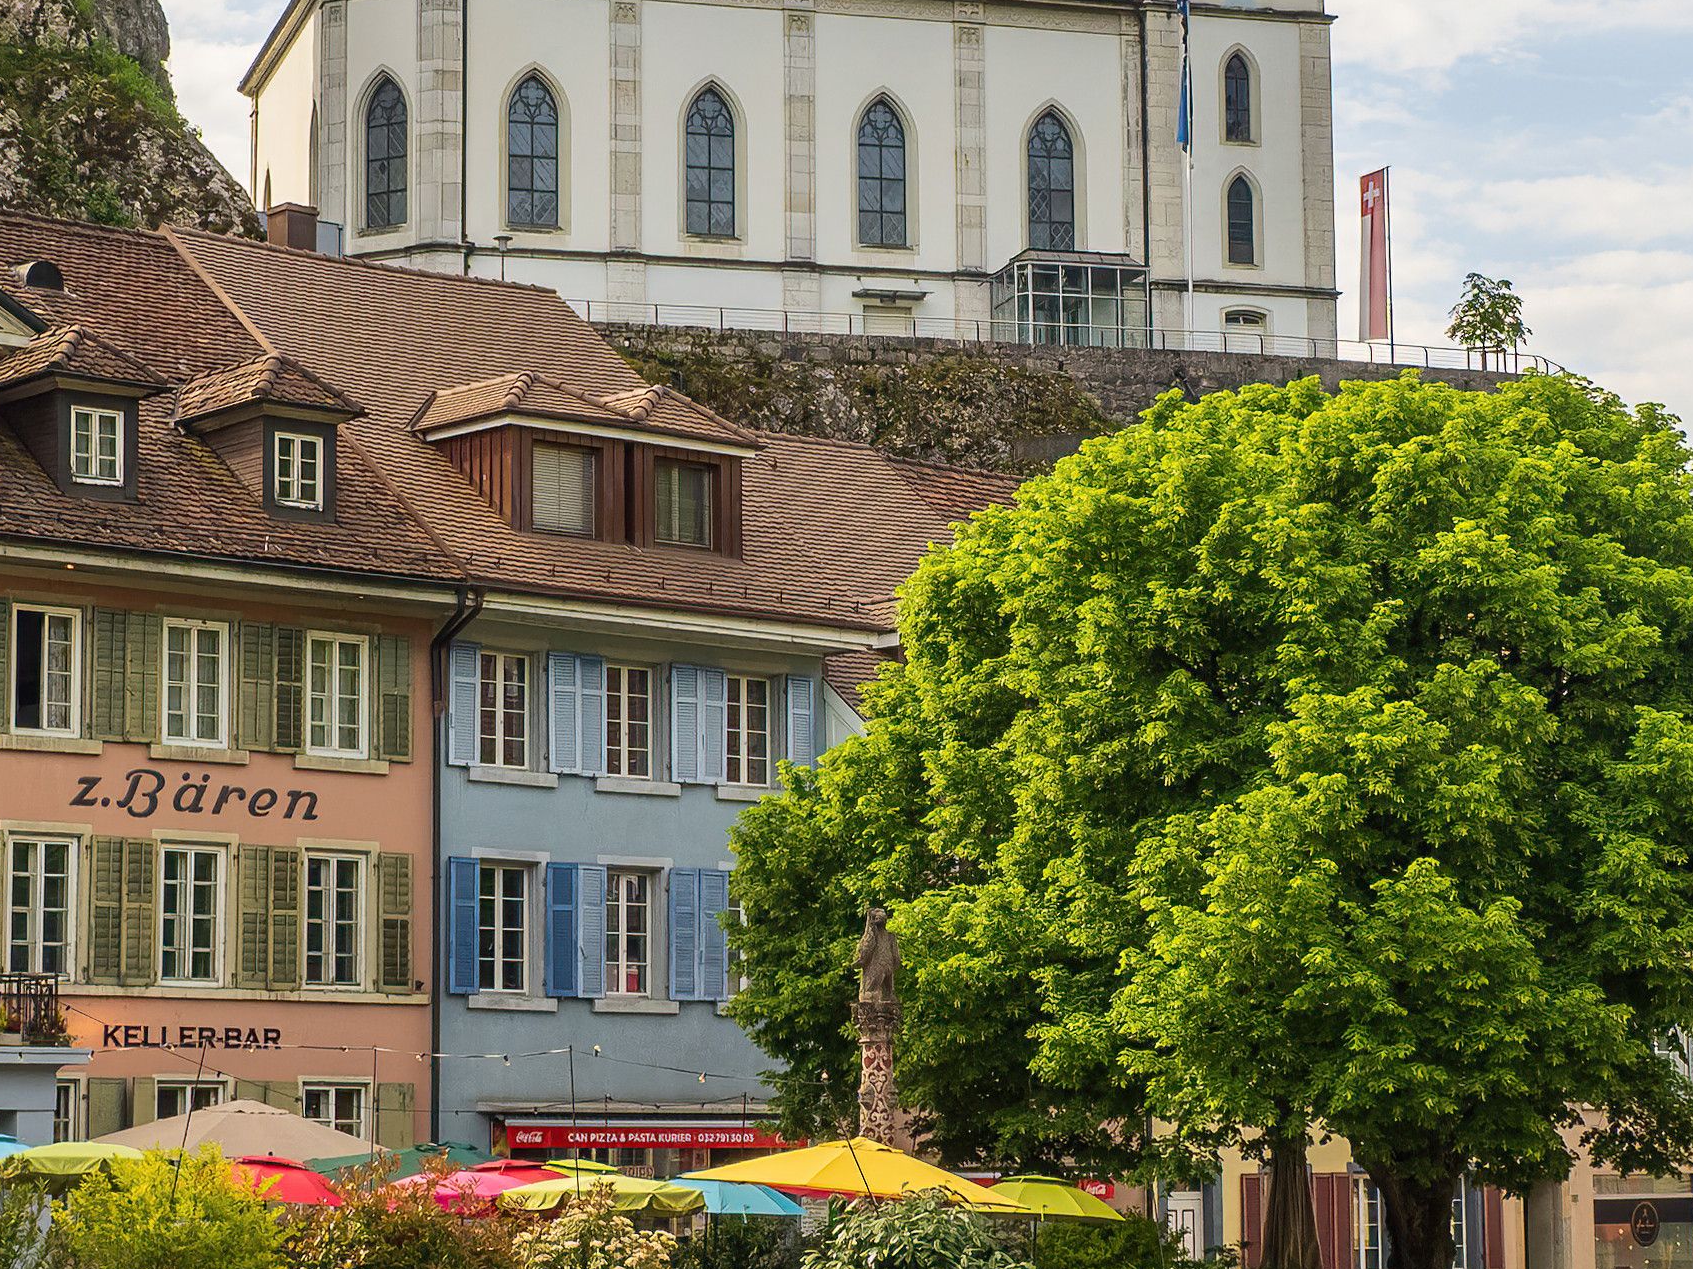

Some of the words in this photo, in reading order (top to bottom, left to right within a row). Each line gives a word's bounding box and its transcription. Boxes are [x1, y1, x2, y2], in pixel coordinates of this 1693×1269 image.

[103, 1025, 282, 1050] KELLER-BAR
[568, 1133, 587, 1143] CAN
[590, 1133, 618, 1143] PIZZA
[619, 1133, 626, 1142] &
[628, 1133, 656, 1143] PASTA
[658, 1133, 692, 1143] KURIER
